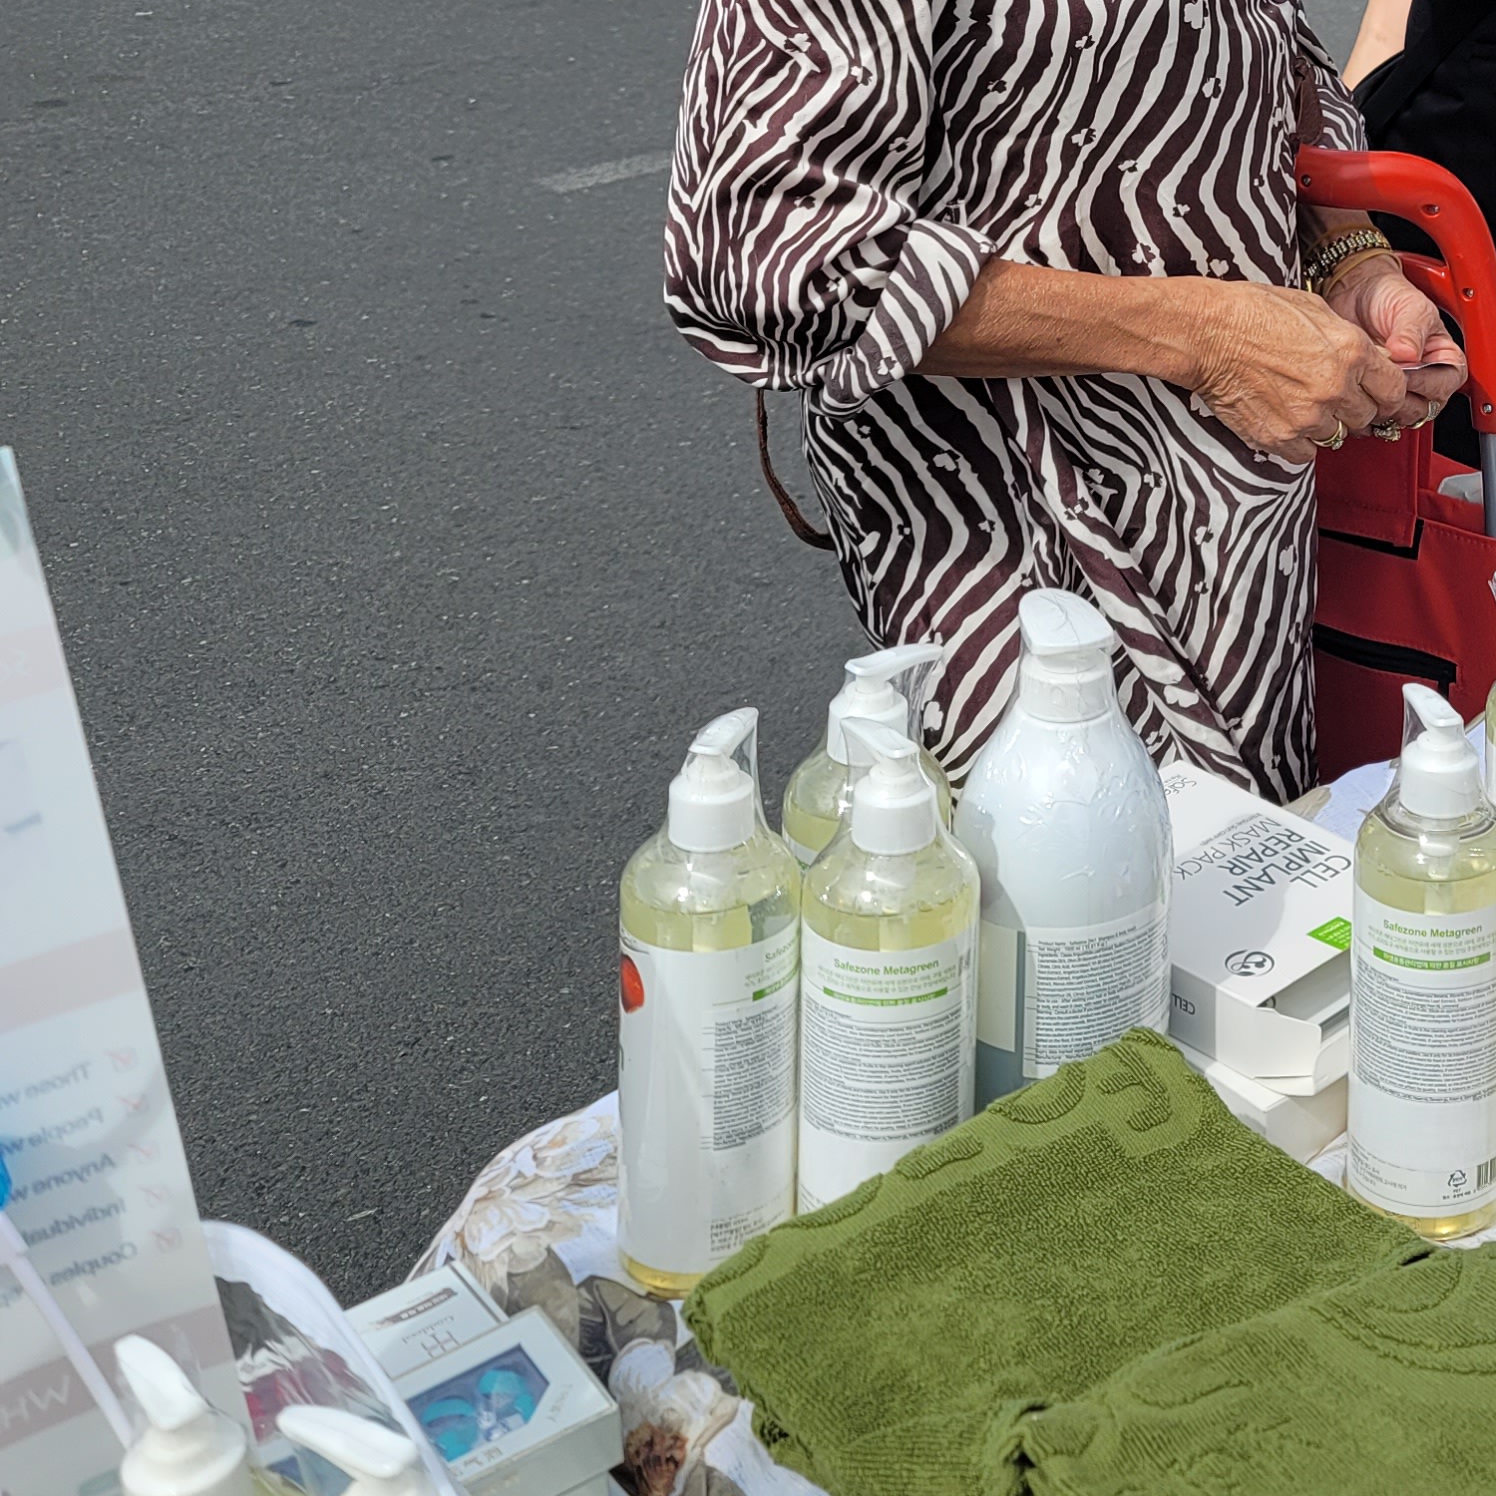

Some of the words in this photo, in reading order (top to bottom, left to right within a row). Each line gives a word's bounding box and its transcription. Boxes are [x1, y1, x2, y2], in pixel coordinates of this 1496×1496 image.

[1218, 816, 1282, 853] MASK
[1172, 846, 1228, 881] PACK
[1217, 828, 1306, 877] REPAIR
[1222, 840, 1331, 907] IMPLANT
[1289, 854, 1352, 889] CELL
[1383, 919, 1427, 938] Safezone
[1430, 924, 1483, 939] Metagreen
[833, 958, 881, 976] Safezone
[883, 959, 940, 976] Metagreen
